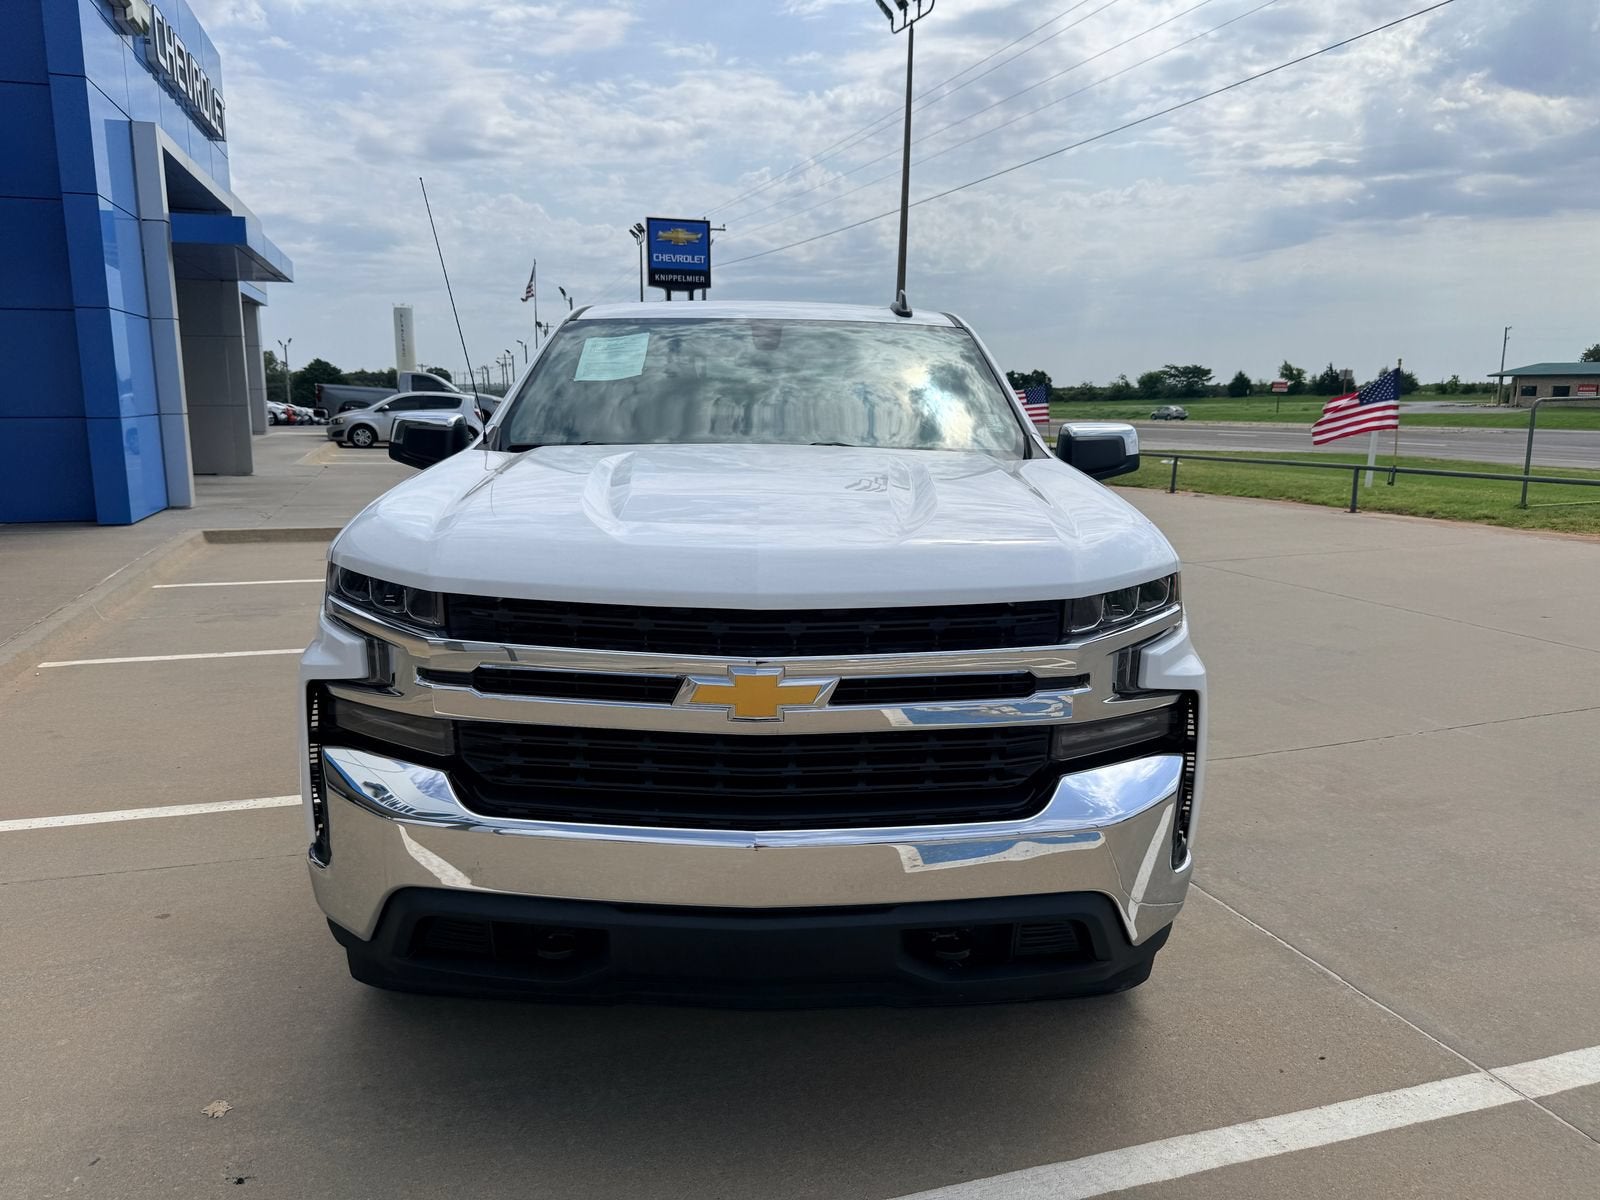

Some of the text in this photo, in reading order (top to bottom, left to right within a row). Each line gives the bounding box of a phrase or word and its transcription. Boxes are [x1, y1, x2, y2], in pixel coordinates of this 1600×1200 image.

[150, 4, 226, 141] CHEVROLET
[653, 253, 706, 264] CHEVROLET
[654, 273, 705, 283] KNIPPELMIER
